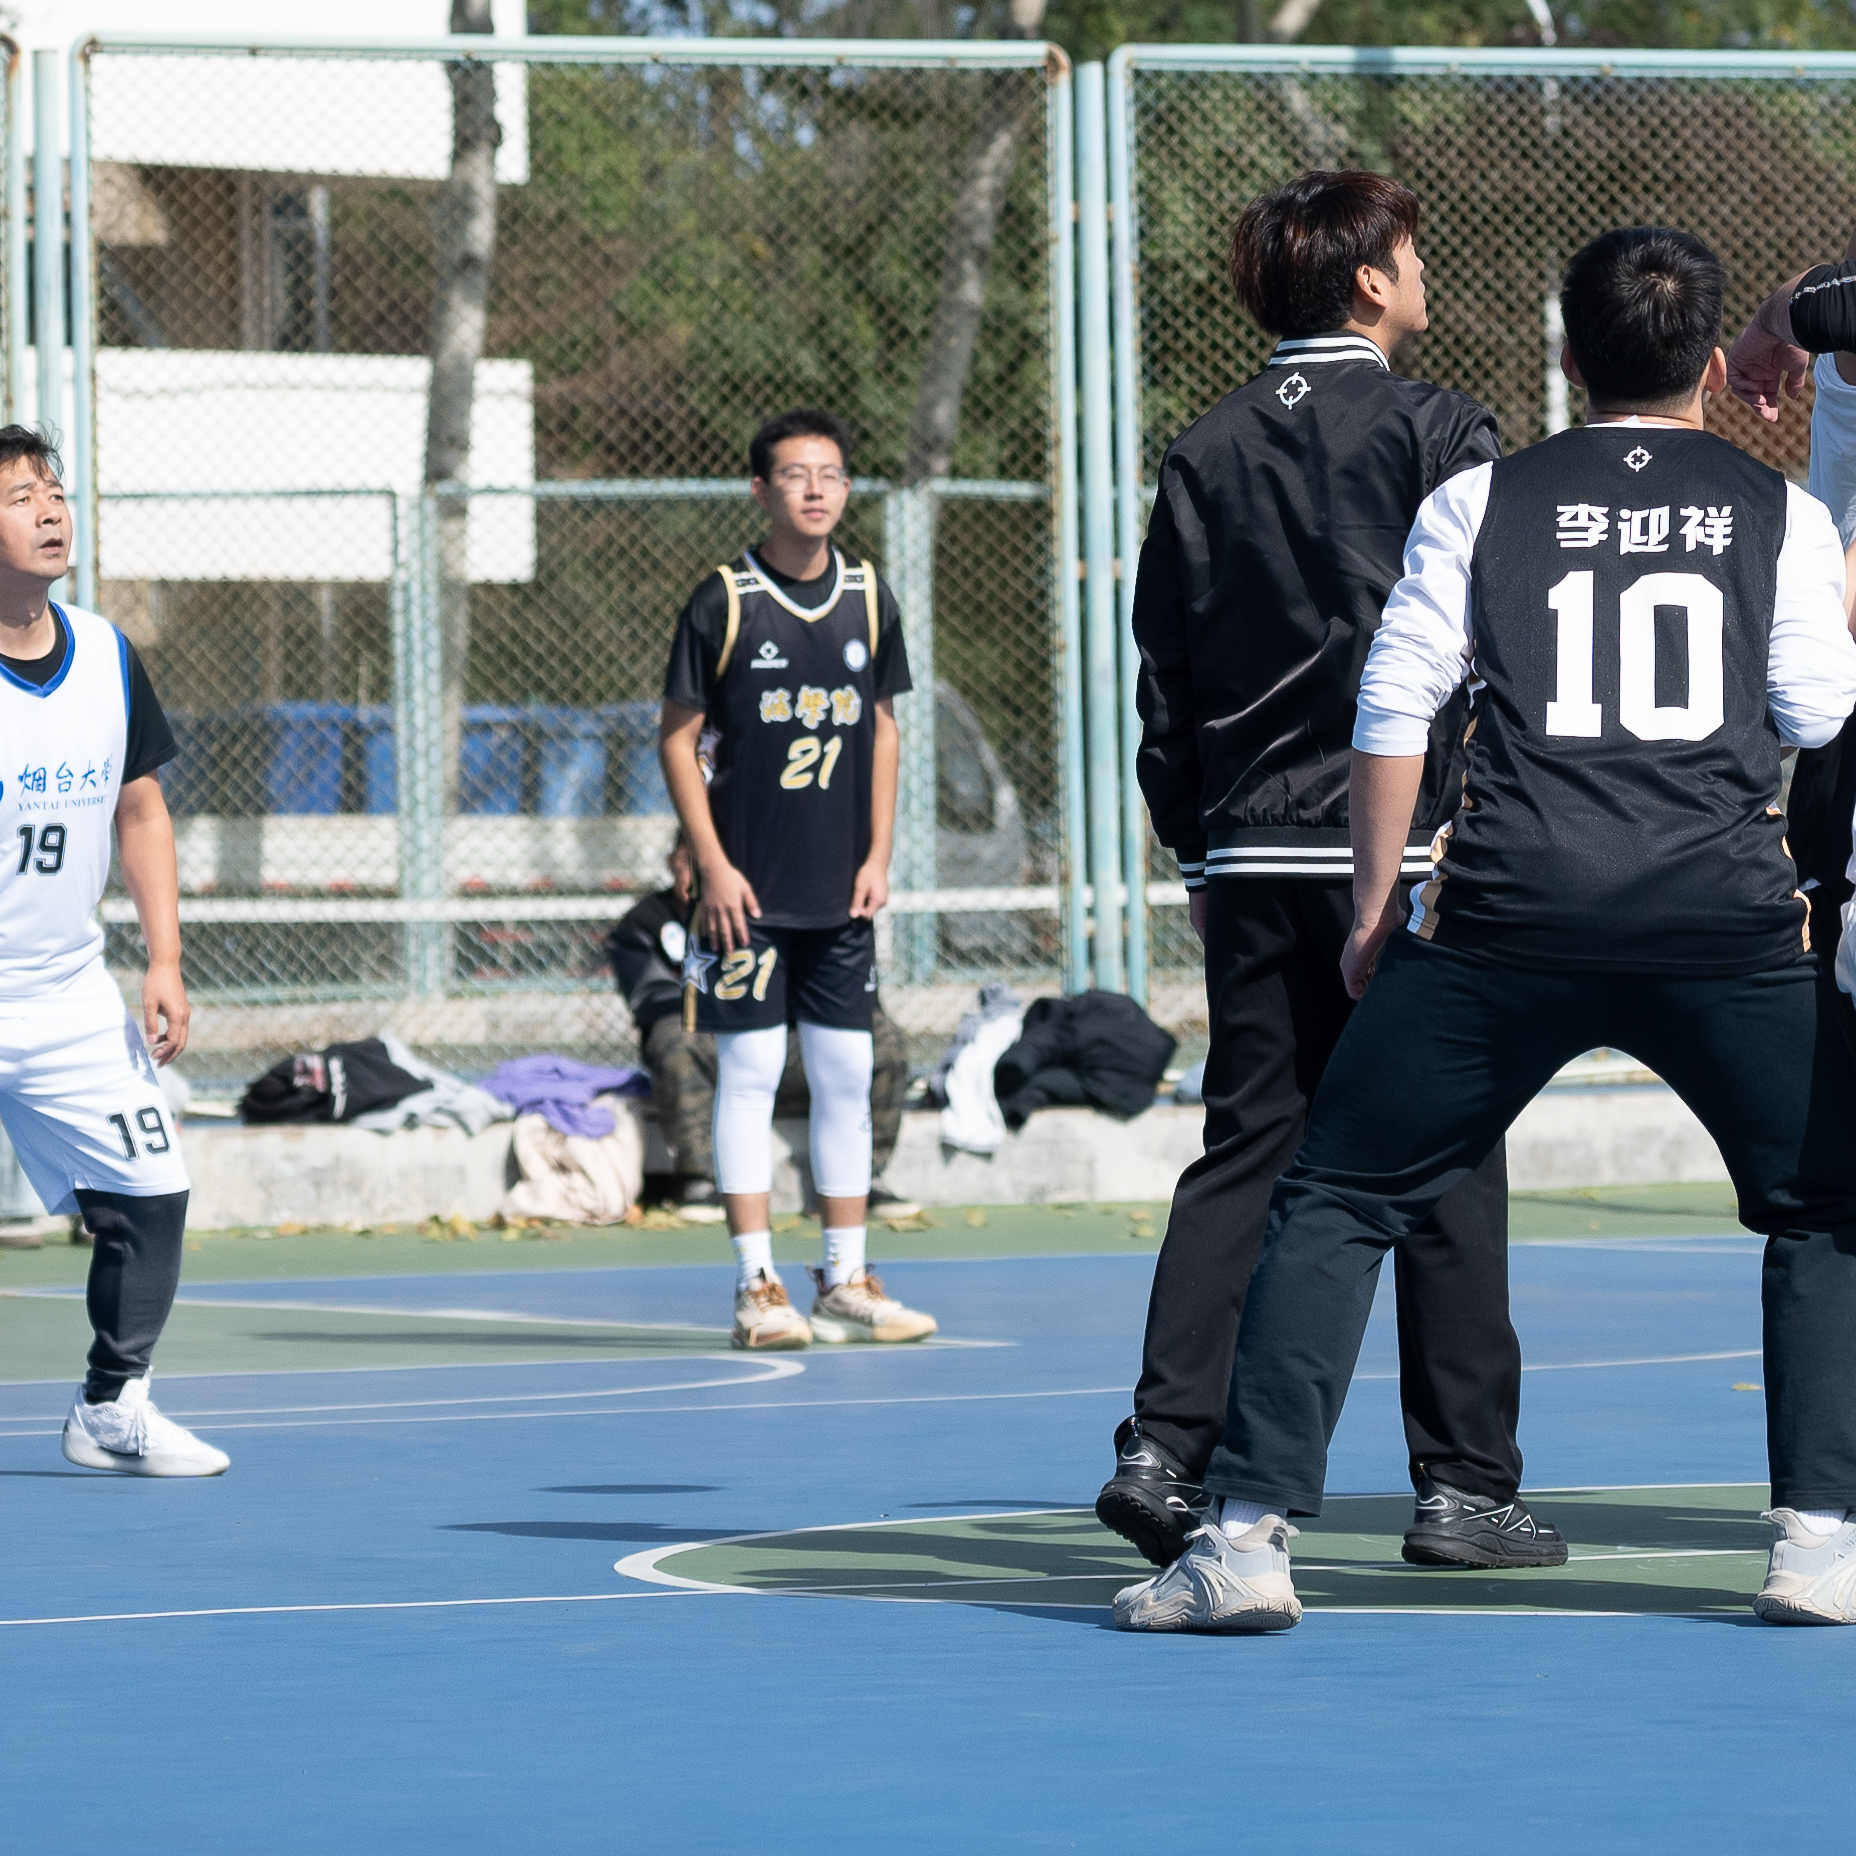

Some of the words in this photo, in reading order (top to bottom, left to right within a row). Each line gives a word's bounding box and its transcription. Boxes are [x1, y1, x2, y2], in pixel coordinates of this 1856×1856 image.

[1555, 503, 1734, 555] 李迎祥
[1546, 570, 1724, 741] 10
[780, 735, 842, 790] 21
[17, 801, 59, 811] YANTAI
[16, 823, 67, 876] 19
[714, 947, 778, 1002] 21
[106, 1104, 170, 1161] 19
